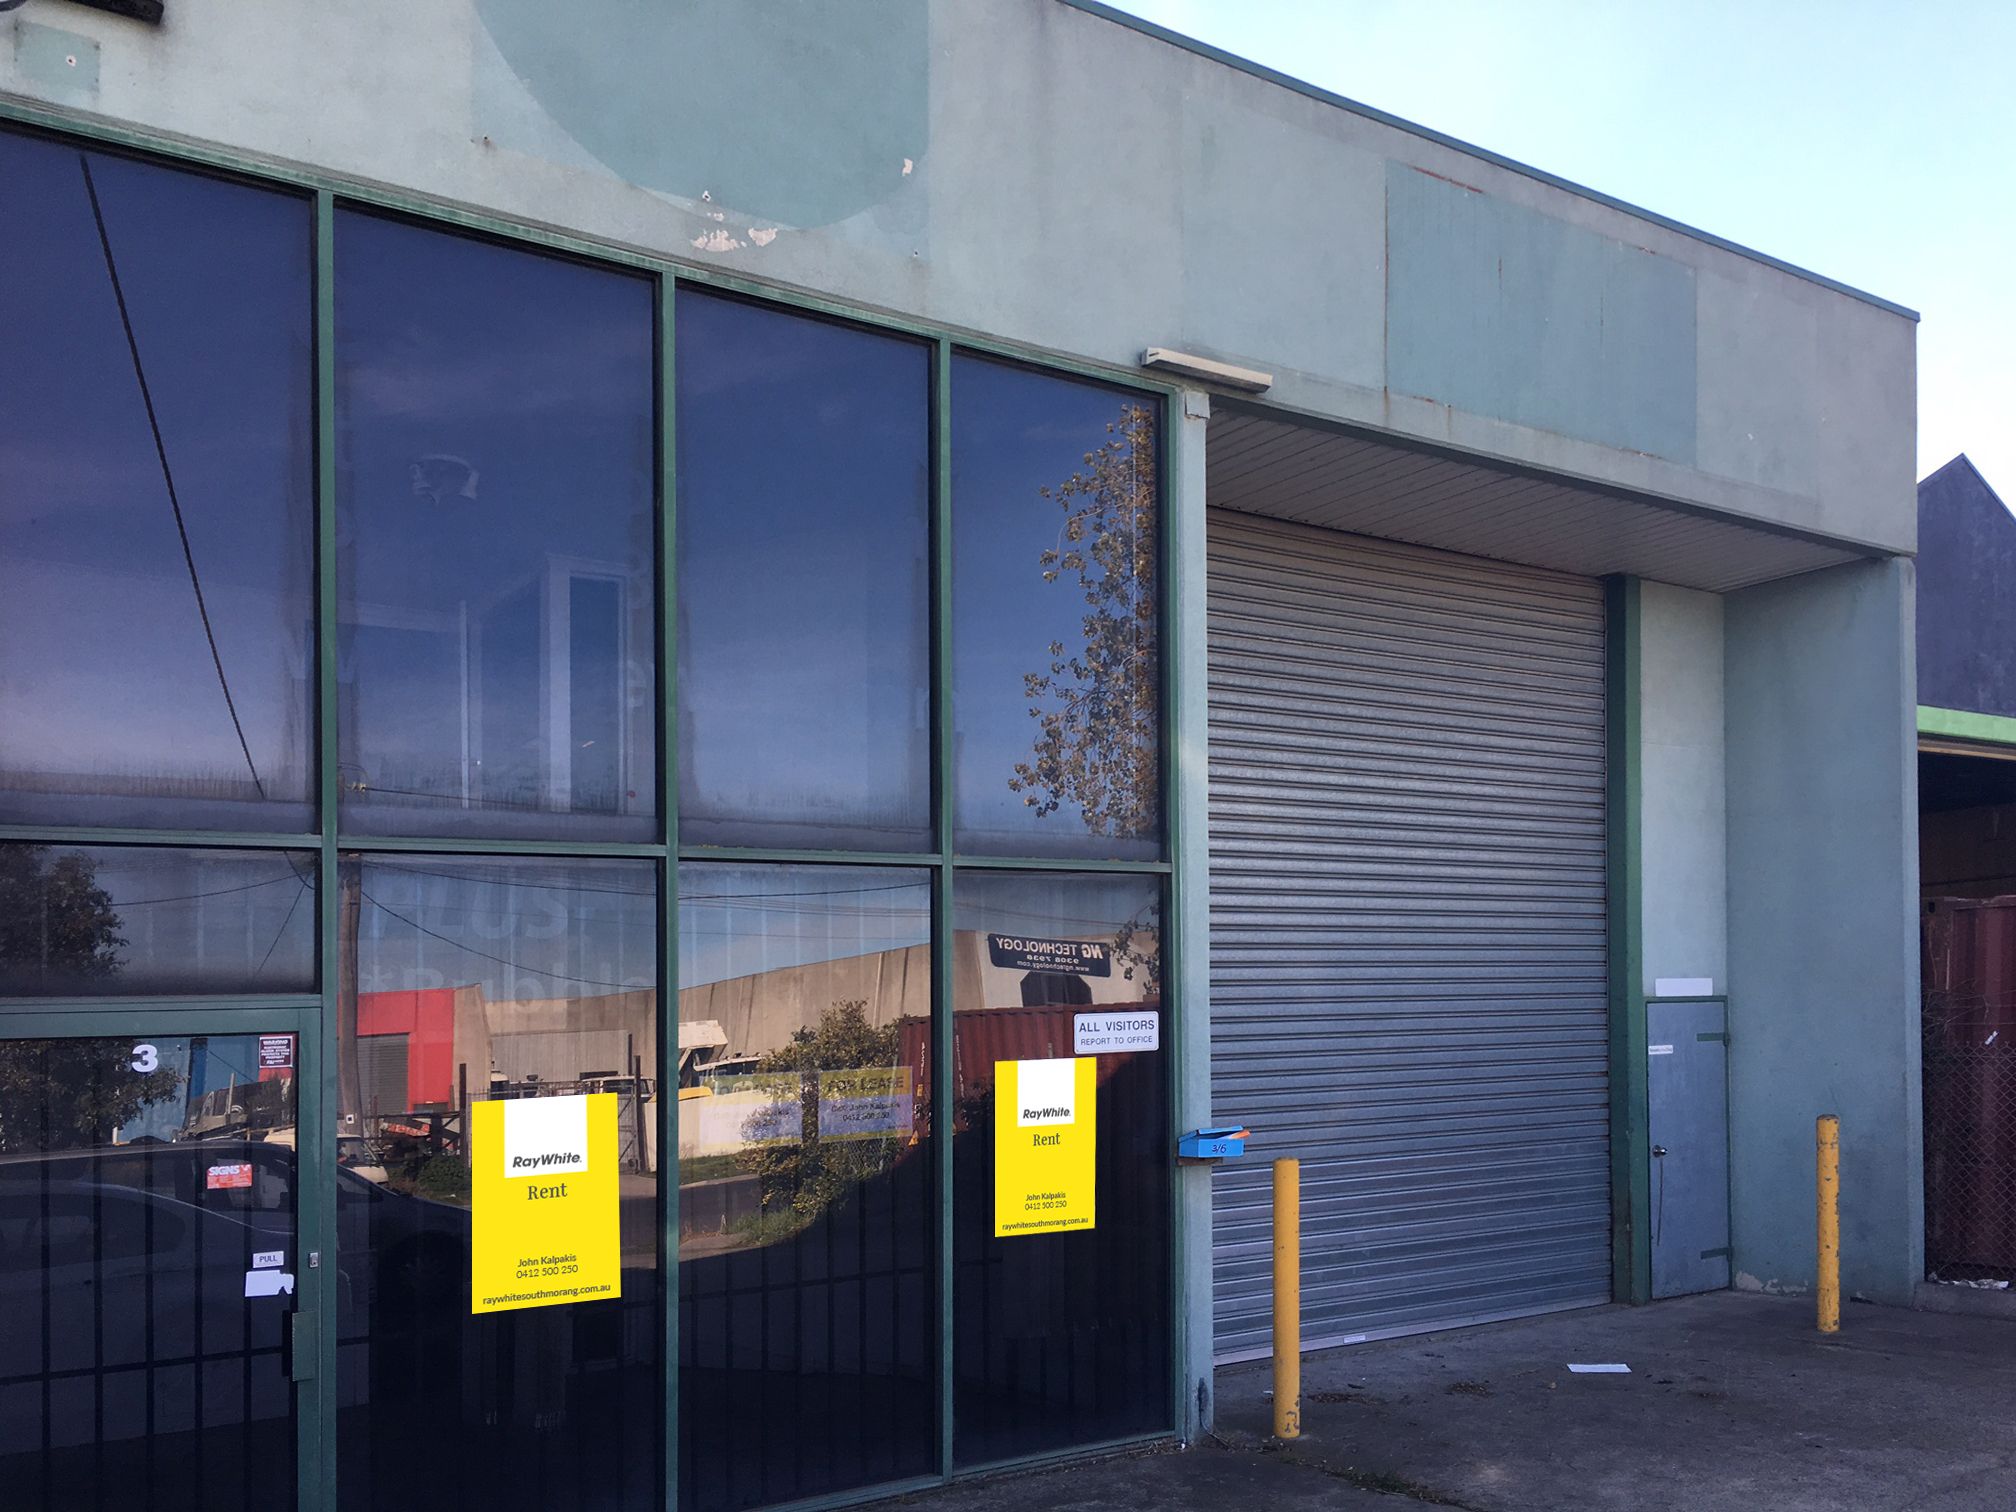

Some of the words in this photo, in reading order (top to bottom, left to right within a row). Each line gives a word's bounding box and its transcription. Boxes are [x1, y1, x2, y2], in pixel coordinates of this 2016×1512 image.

[1079, 1022, 1100, 1032] ALL
[1105, 1020, 1155, 1031] VISITORS
[1080, 1038, 1111, 1046] REPORT
[1127, 1035, 1153, 1043] OFFICE
[131, 1044, 158, 1073] 3
[1033, 1133, 1061, 1146] Rent
[1211, 1143, 1227, 1153] 3/6
[527, 1183, 568, 1200] Rent
[1041, 1192, 1066, 1201] Kalpakis
[1024, 1202, 1040, 1210] 0412
[1042, 1201, 1054, 1209] 500
[1055, 1200, 1067, 1208] 250
[1002, 1217, 1088, 1231] raywhitesouthmorang.com.au
[259, 1254, 277, 1262] PULL
[517, 1258, 539, 1268] John
[541, 1253, 577, 1266] Kalpakis
[516, 1269, 539, 1279] 0412
[542, 1266, 559, 1276] 500
[561, 1264, 579, 1274] 250
[482, 1284, 611, 1306] raywhitesouthmorang.com.au
